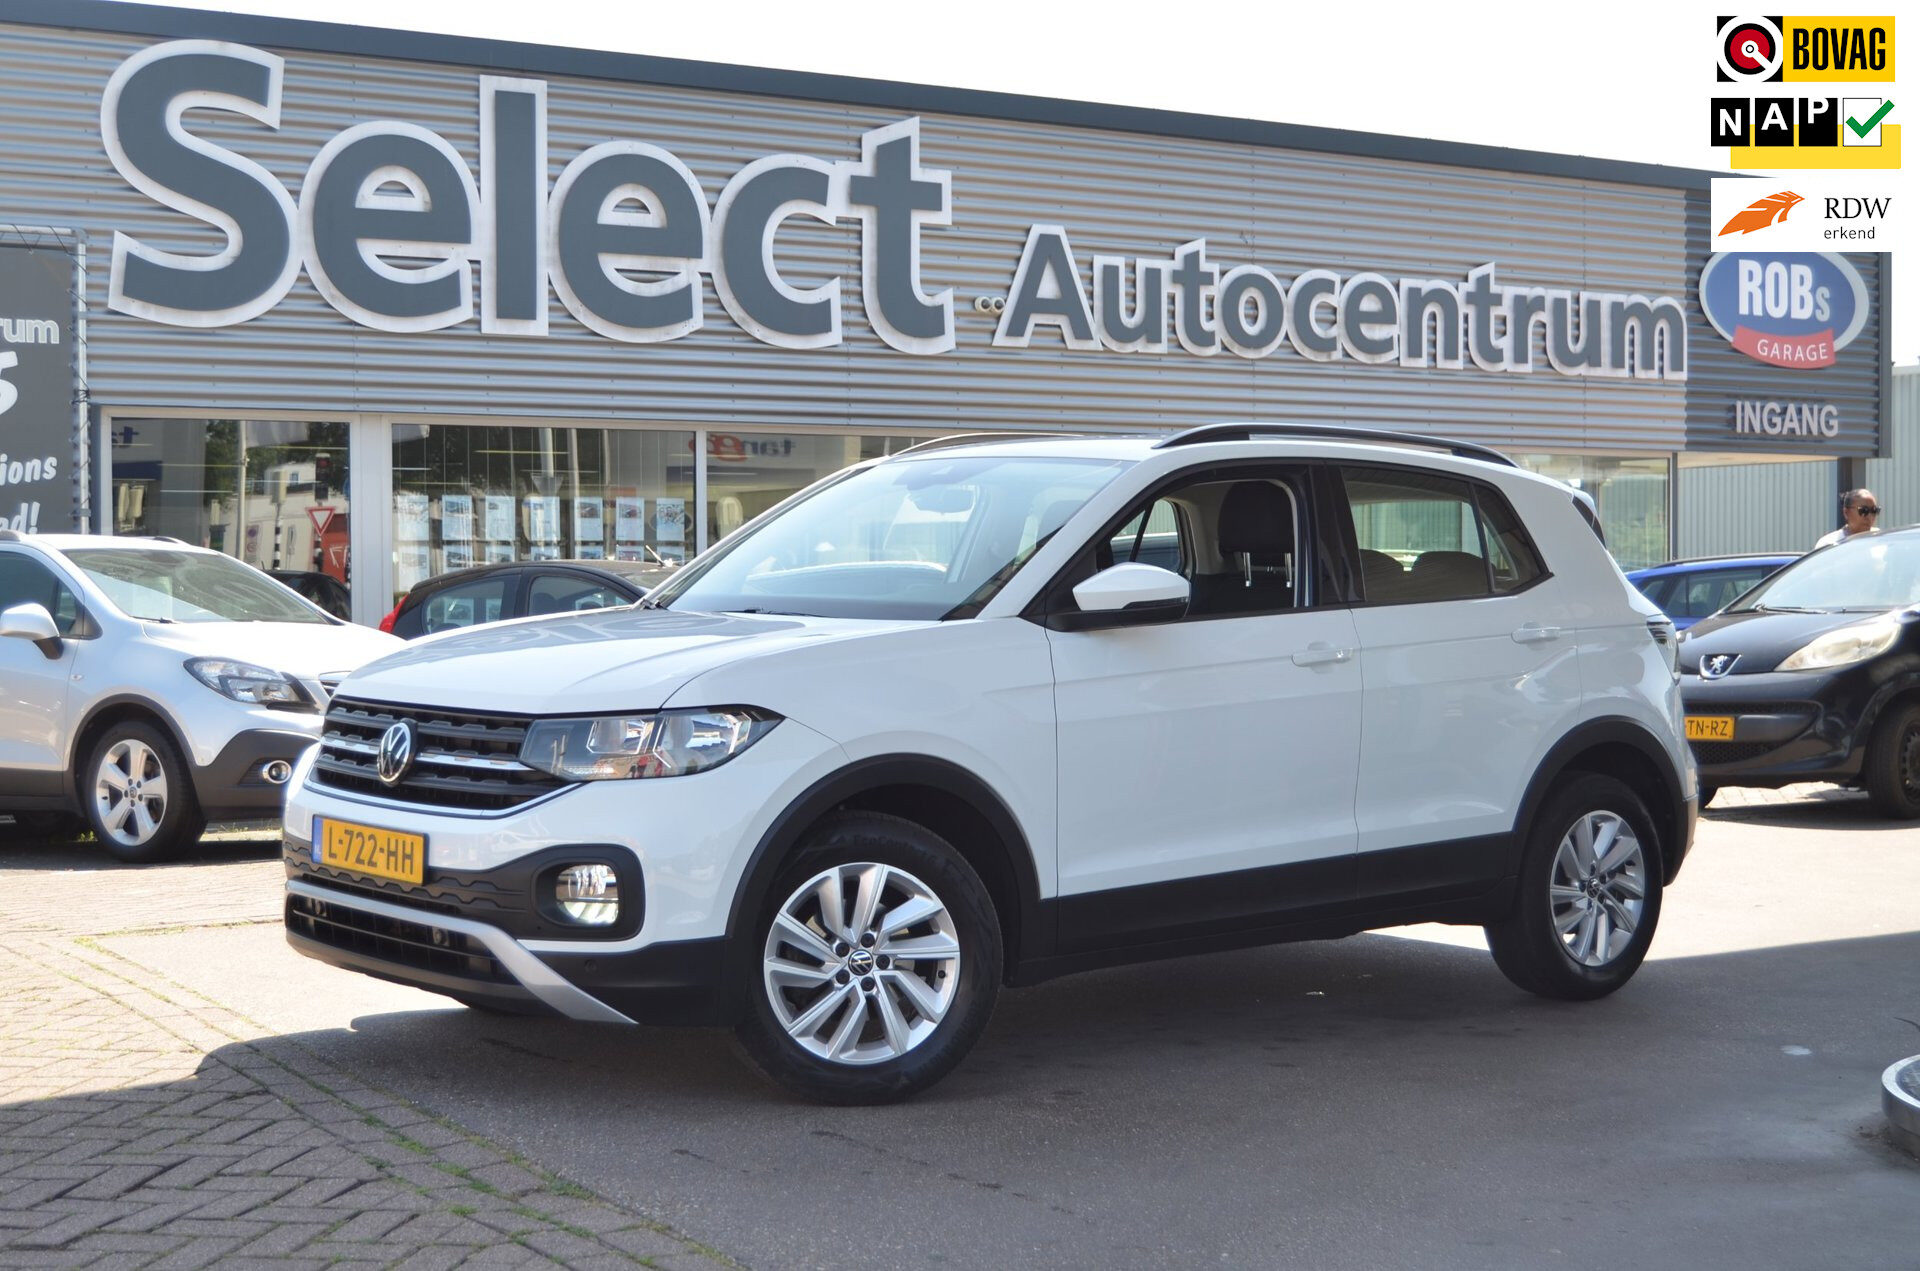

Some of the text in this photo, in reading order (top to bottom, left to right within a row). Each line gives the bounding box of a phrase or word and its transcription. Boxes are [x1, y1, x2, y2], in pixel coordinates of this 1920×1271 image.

[100, 39, 1688, 381] Select Autocentrum
[1738, 259, 1831, 322] ROBs
[0, 318, 60, 344] um
[1757, 339, 1829, 362] GARAGE
[1735, 400, 1839, 438] INGANG
[328, 826, 415, 875] L-722-HH
